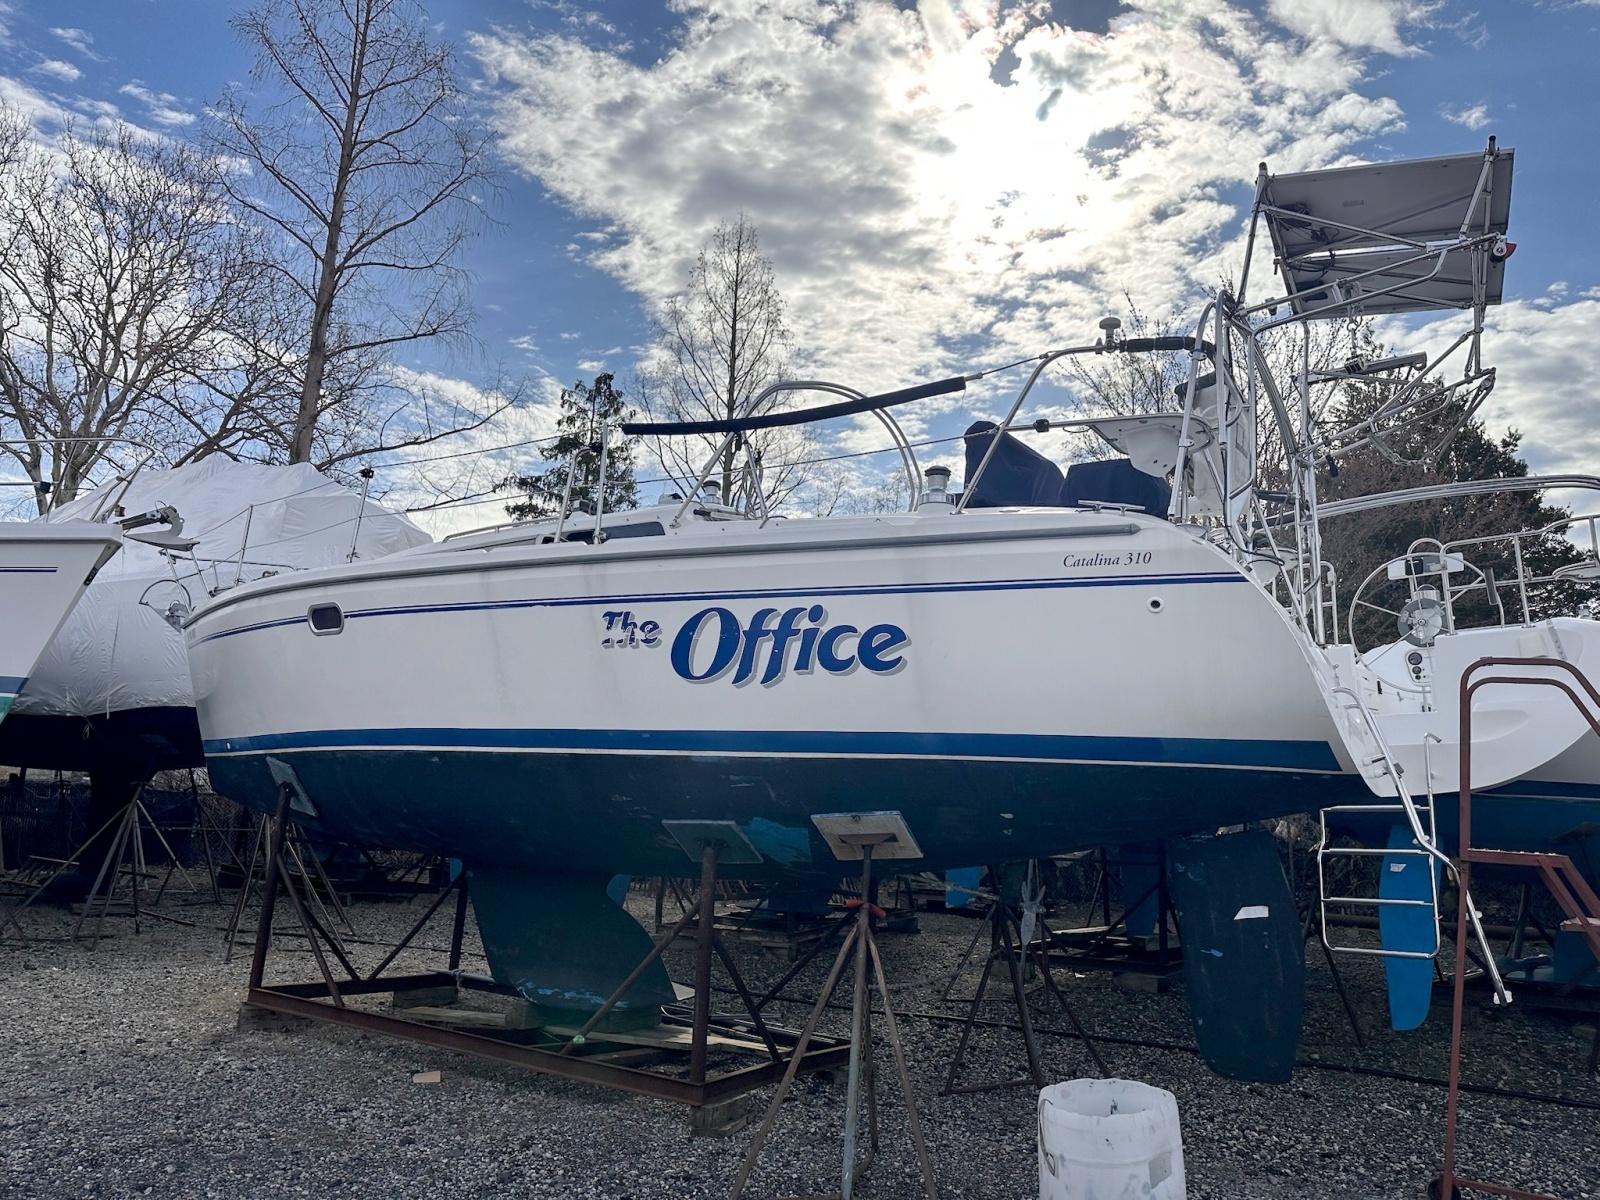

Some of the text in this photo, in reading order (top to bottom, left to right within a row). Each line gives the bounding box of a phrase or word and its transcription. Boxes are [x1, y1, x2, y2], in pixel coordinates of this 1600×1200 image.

[1063, 552, 1152, 568] Catalina 310
[602, 604, 912, 688] The Office
